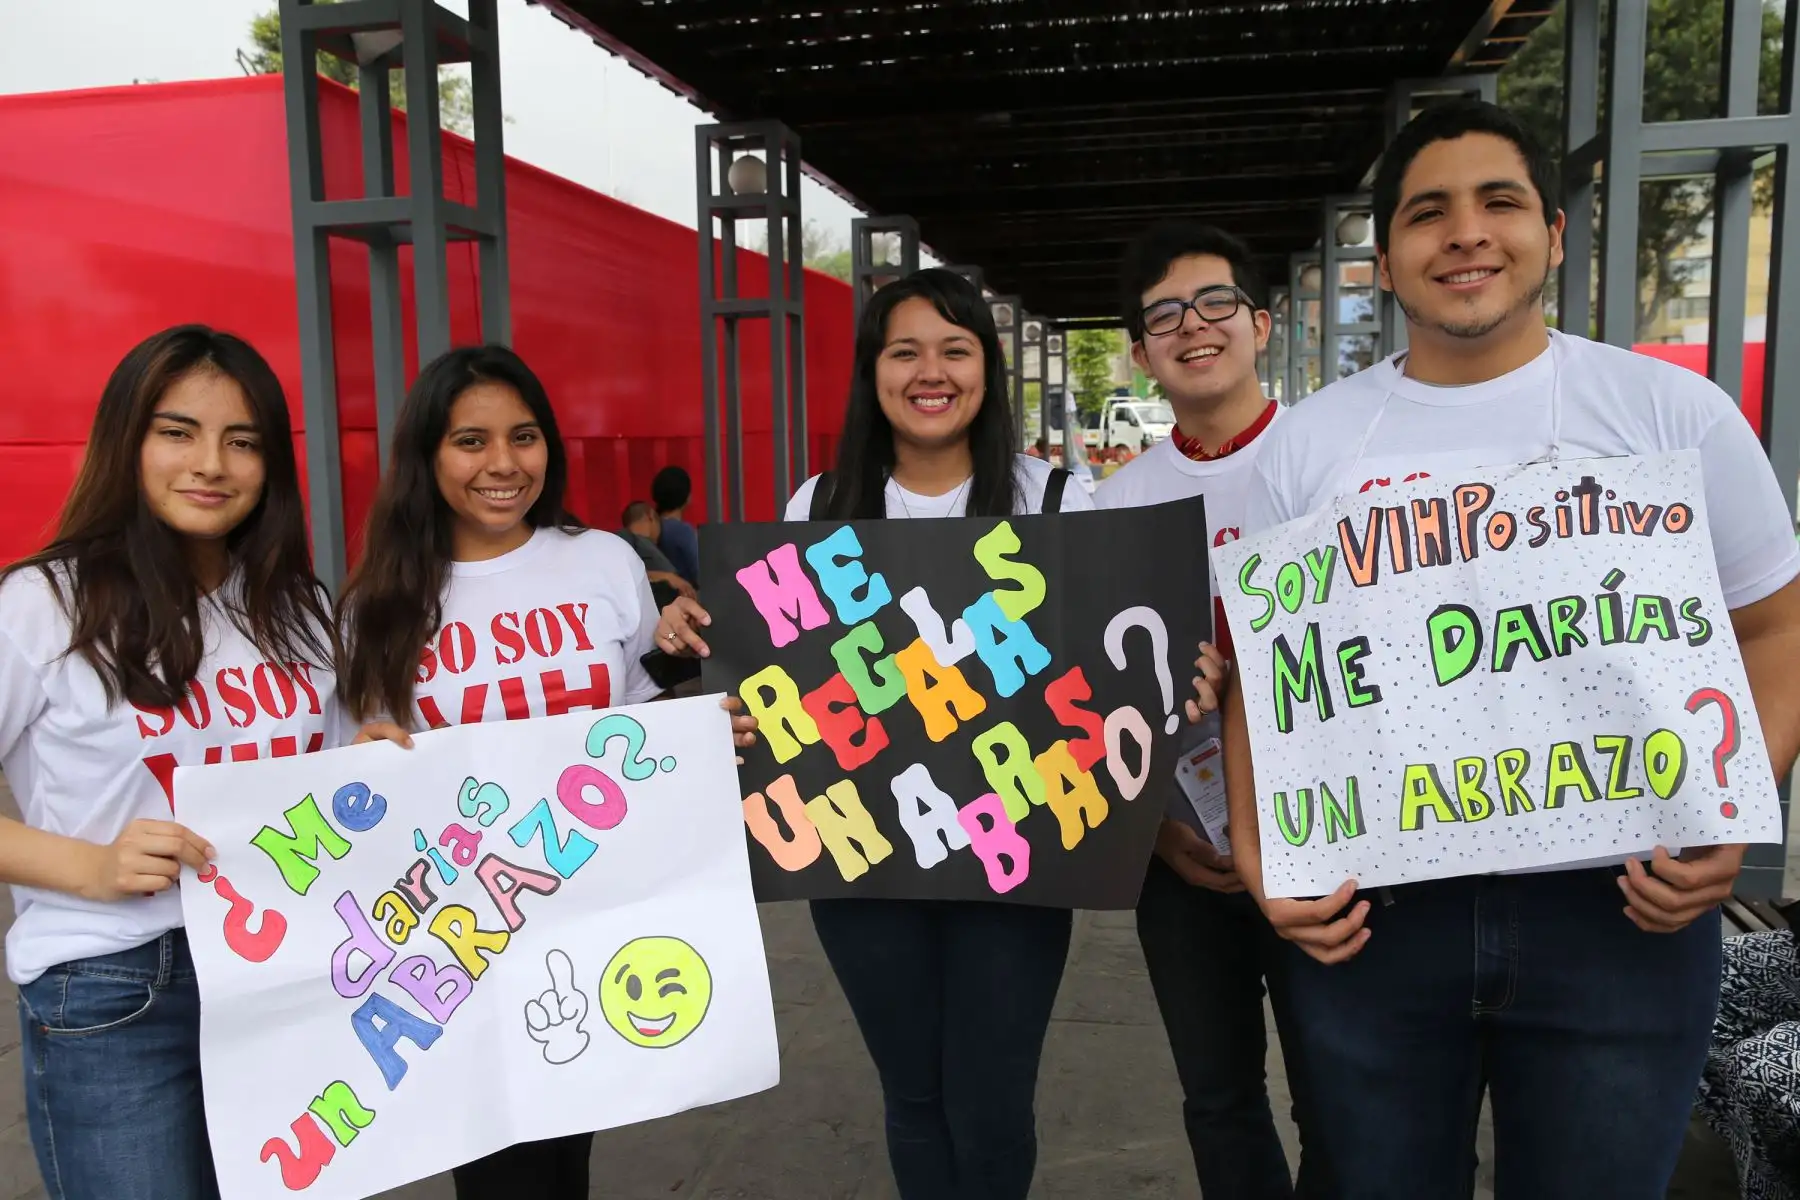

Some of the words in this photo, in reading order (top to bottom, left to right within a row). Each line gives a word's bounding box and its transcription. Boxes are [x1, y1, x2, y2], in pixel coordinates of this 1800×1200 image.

[490, 603, 594, 665] SOY
[736, 525, 892, 648] ME
[1238, 545, 1338, 633] SOY
[1427, 568, 1713, 687] DARÍAS
[215, 661, 322, 728] SOY
[739, 520, 1052, 771] REGALAS
[742, 774, 894, 883] UN
[1274, 775, 1367, 847] UN
[259, 1080, 376, 1191] un
